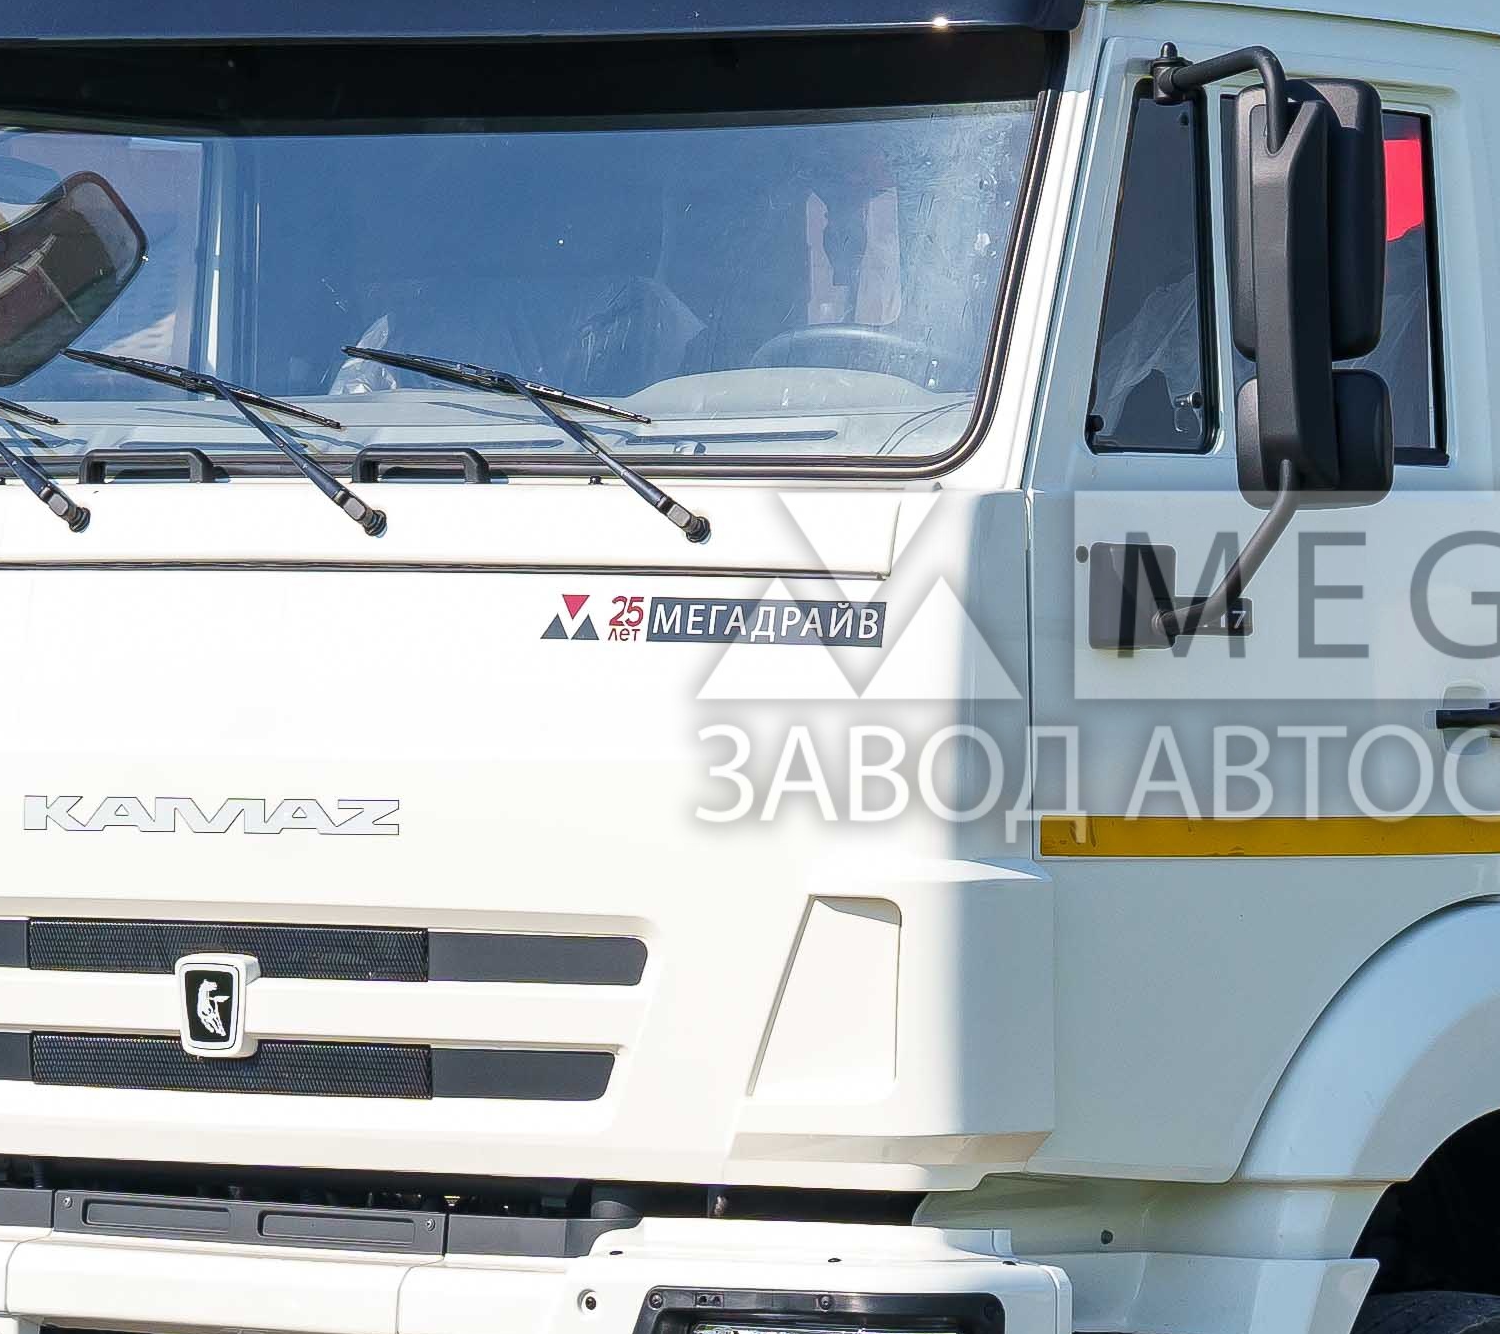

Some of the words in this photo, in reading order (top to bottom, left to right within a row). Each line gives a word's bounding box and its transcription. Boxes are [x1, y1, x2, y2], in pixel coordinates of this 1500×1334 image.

[607, 627, 639, 642] лет
[609, 595, 644, 627] 25
[652, 601, 879, 643] МЕГАДРАЙВ
[23, 794, 400, 836] KAMAZ
